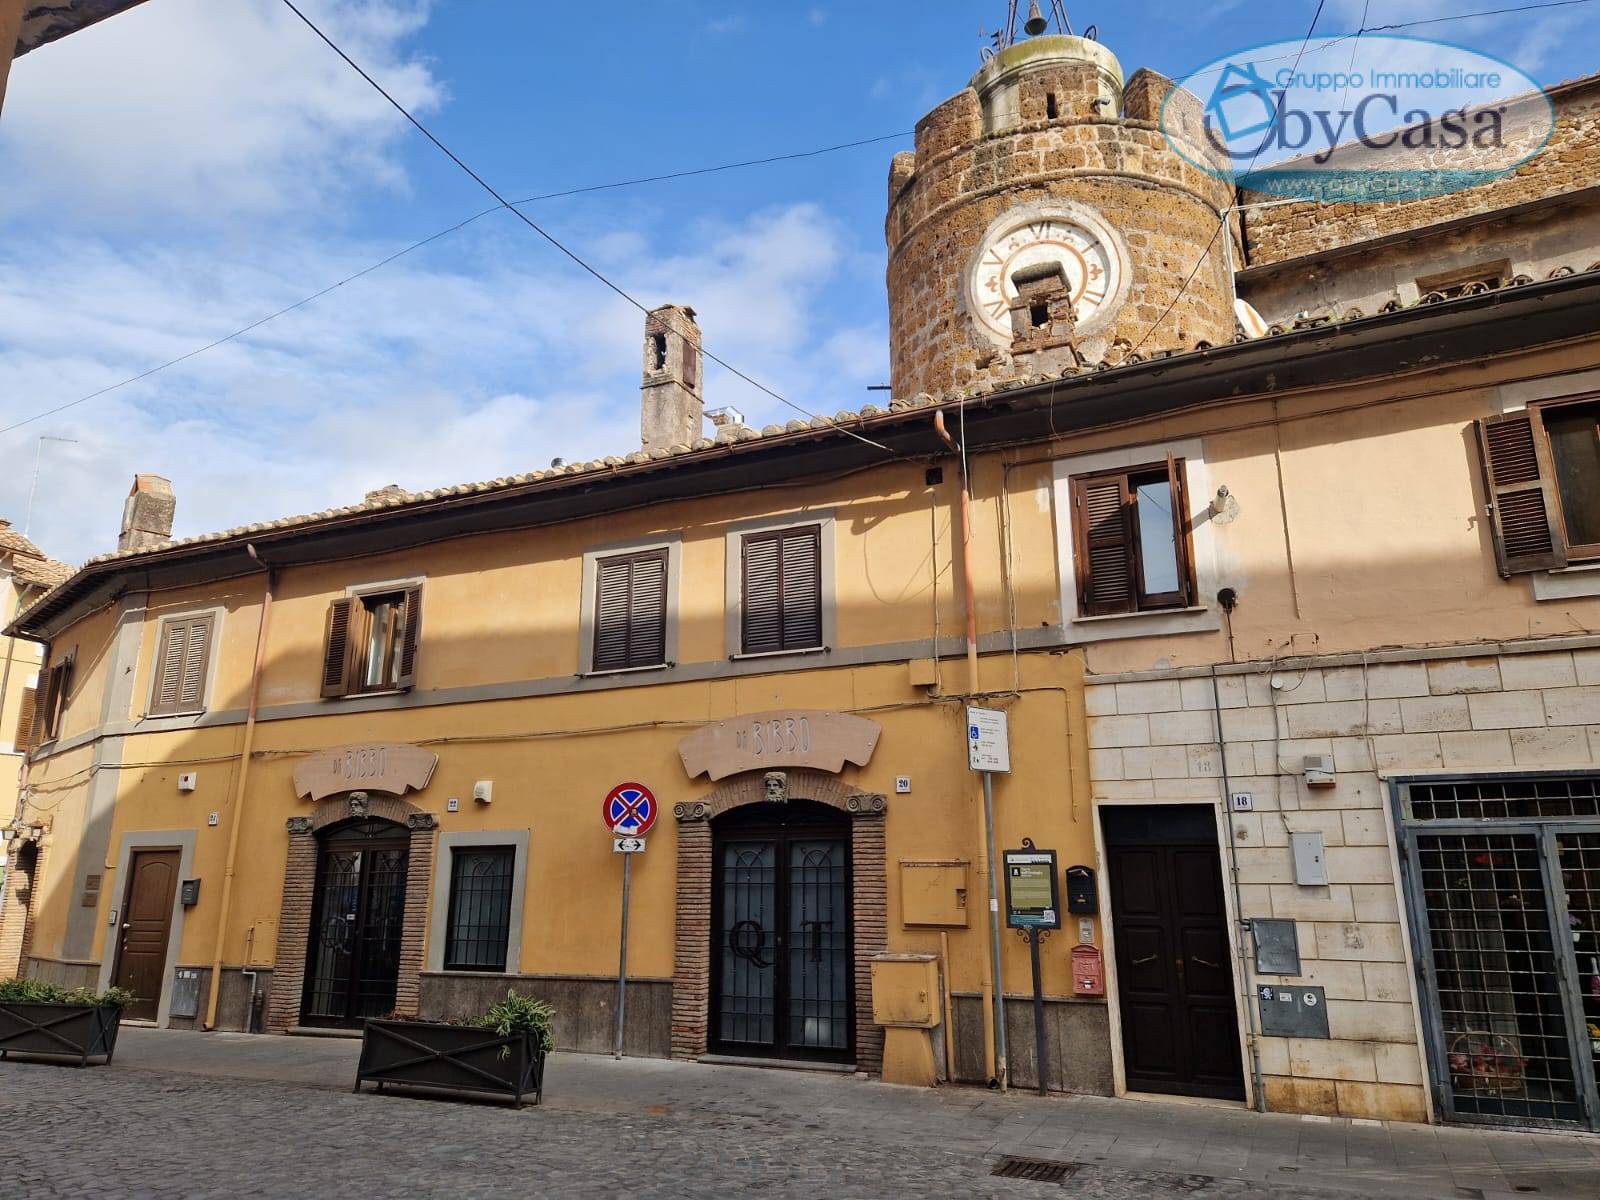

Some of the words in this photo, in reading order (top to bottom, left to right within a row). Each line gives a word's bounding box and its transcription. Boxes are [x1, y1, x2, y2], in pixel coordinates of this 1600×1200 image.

[752, 716, 810, 756] BIBBO
[898, 779, 908, 788] 20
[1236, 796, 1248, 807] 18
